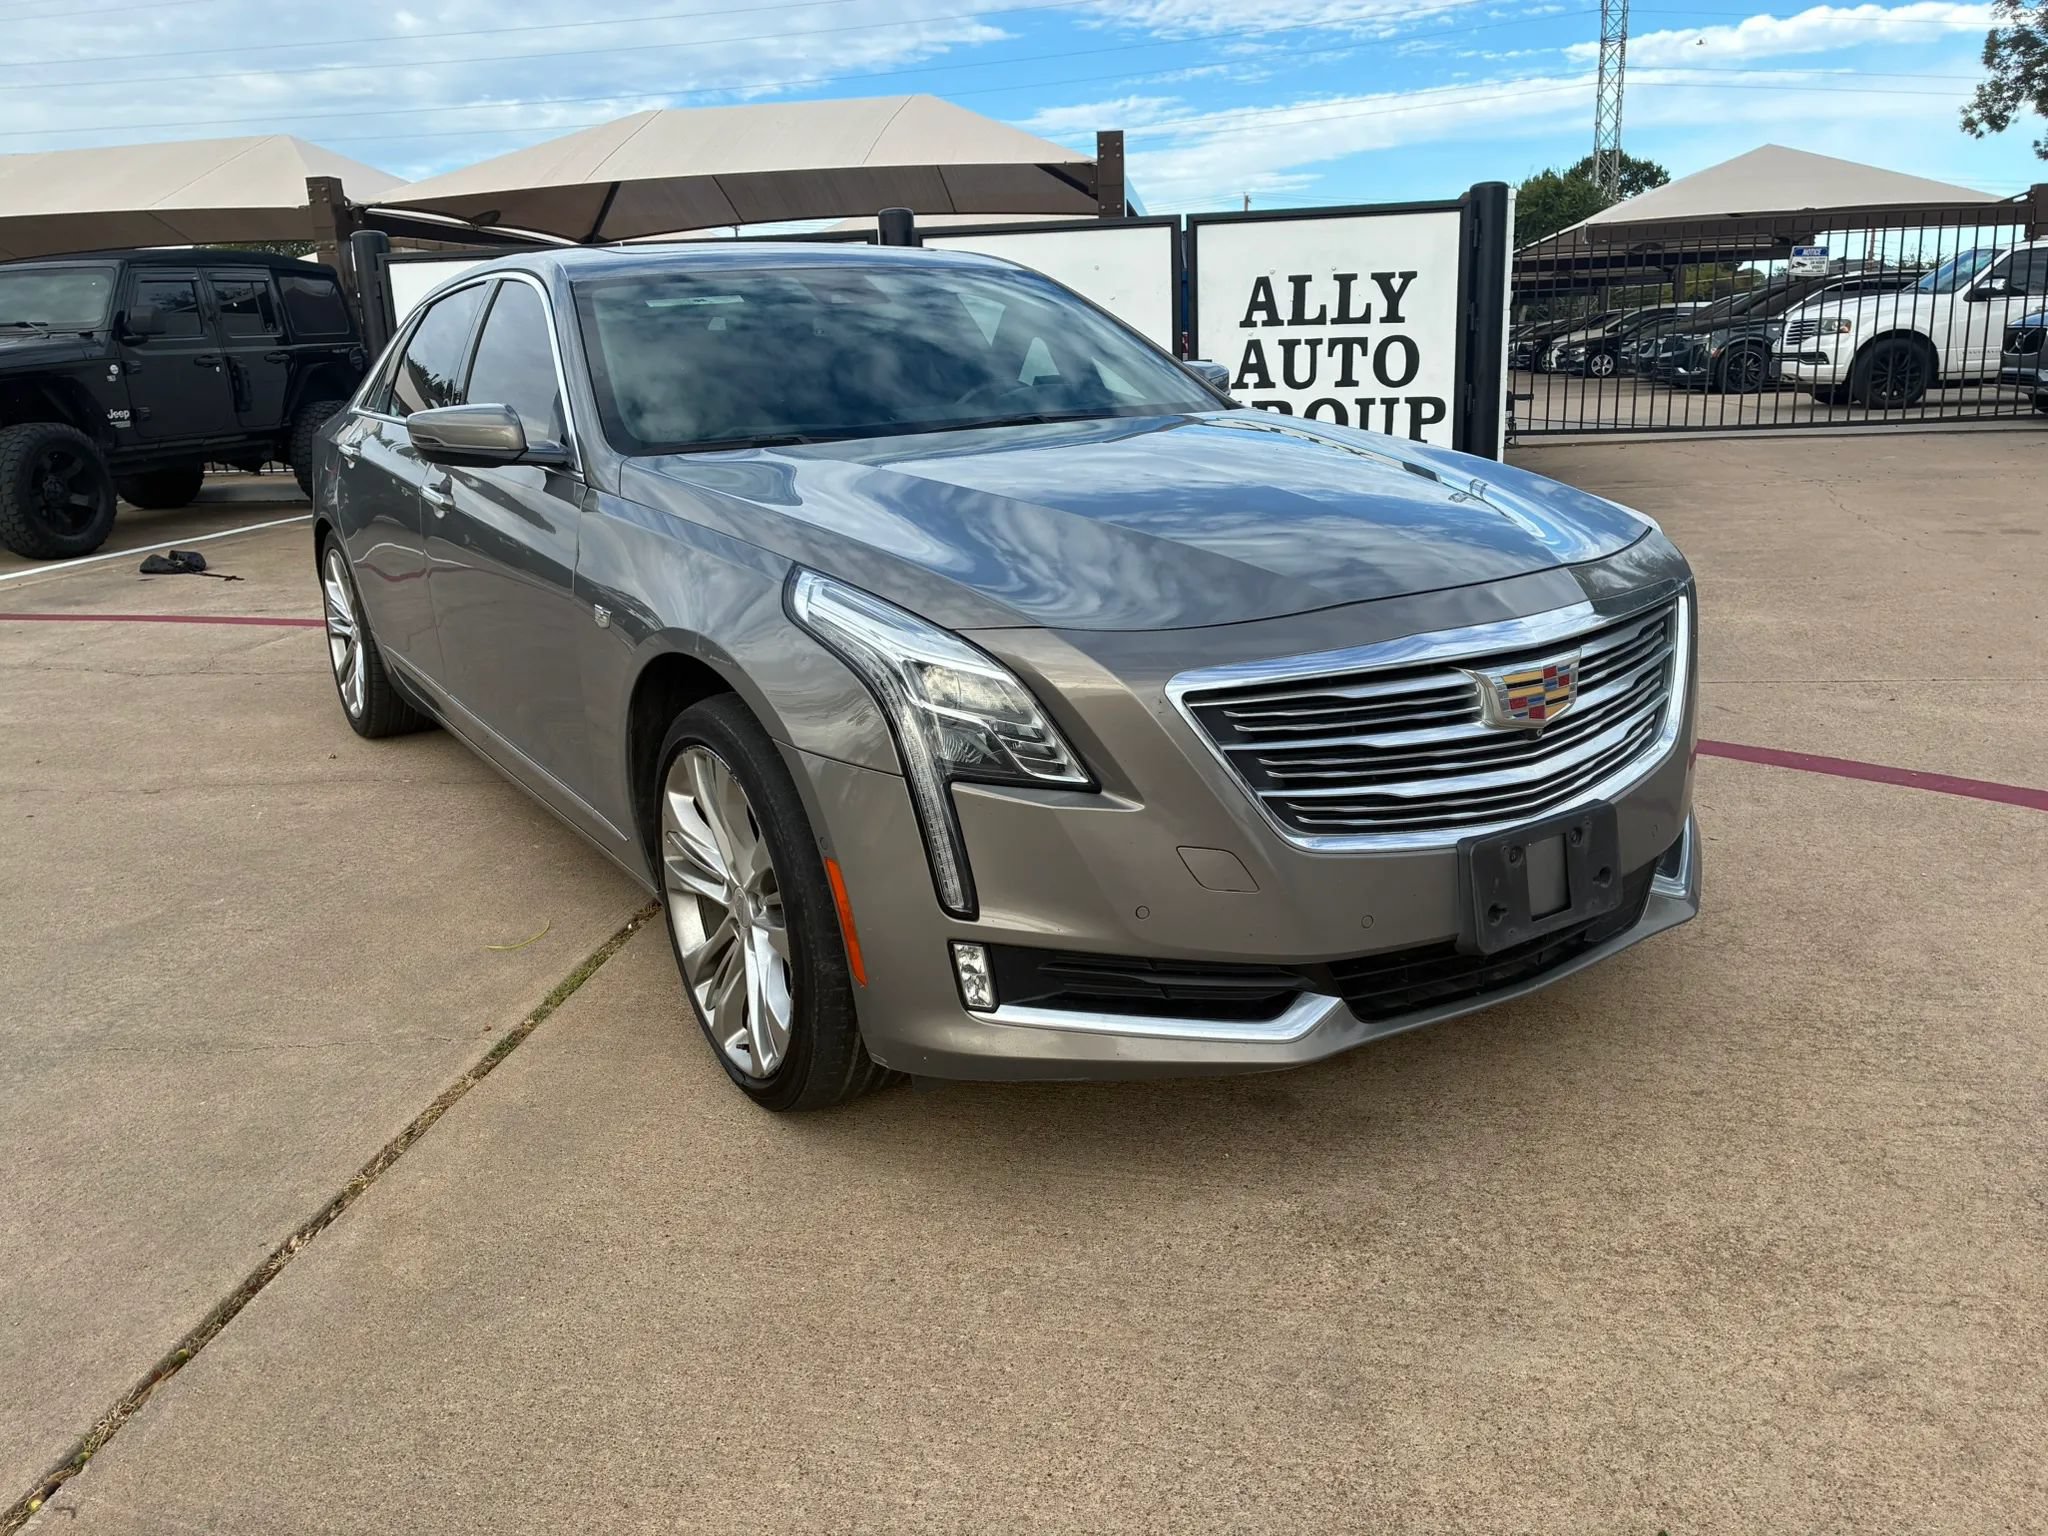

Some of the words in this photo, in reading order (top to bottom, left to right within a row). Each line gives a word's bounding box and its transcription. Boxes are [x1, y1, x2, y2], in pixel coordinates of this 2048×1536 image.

[1240, 271, 1417, 328] ALLY
[1231, 335, 1420, 390] AUTO
[107, 408, 130, 420] Jeep
